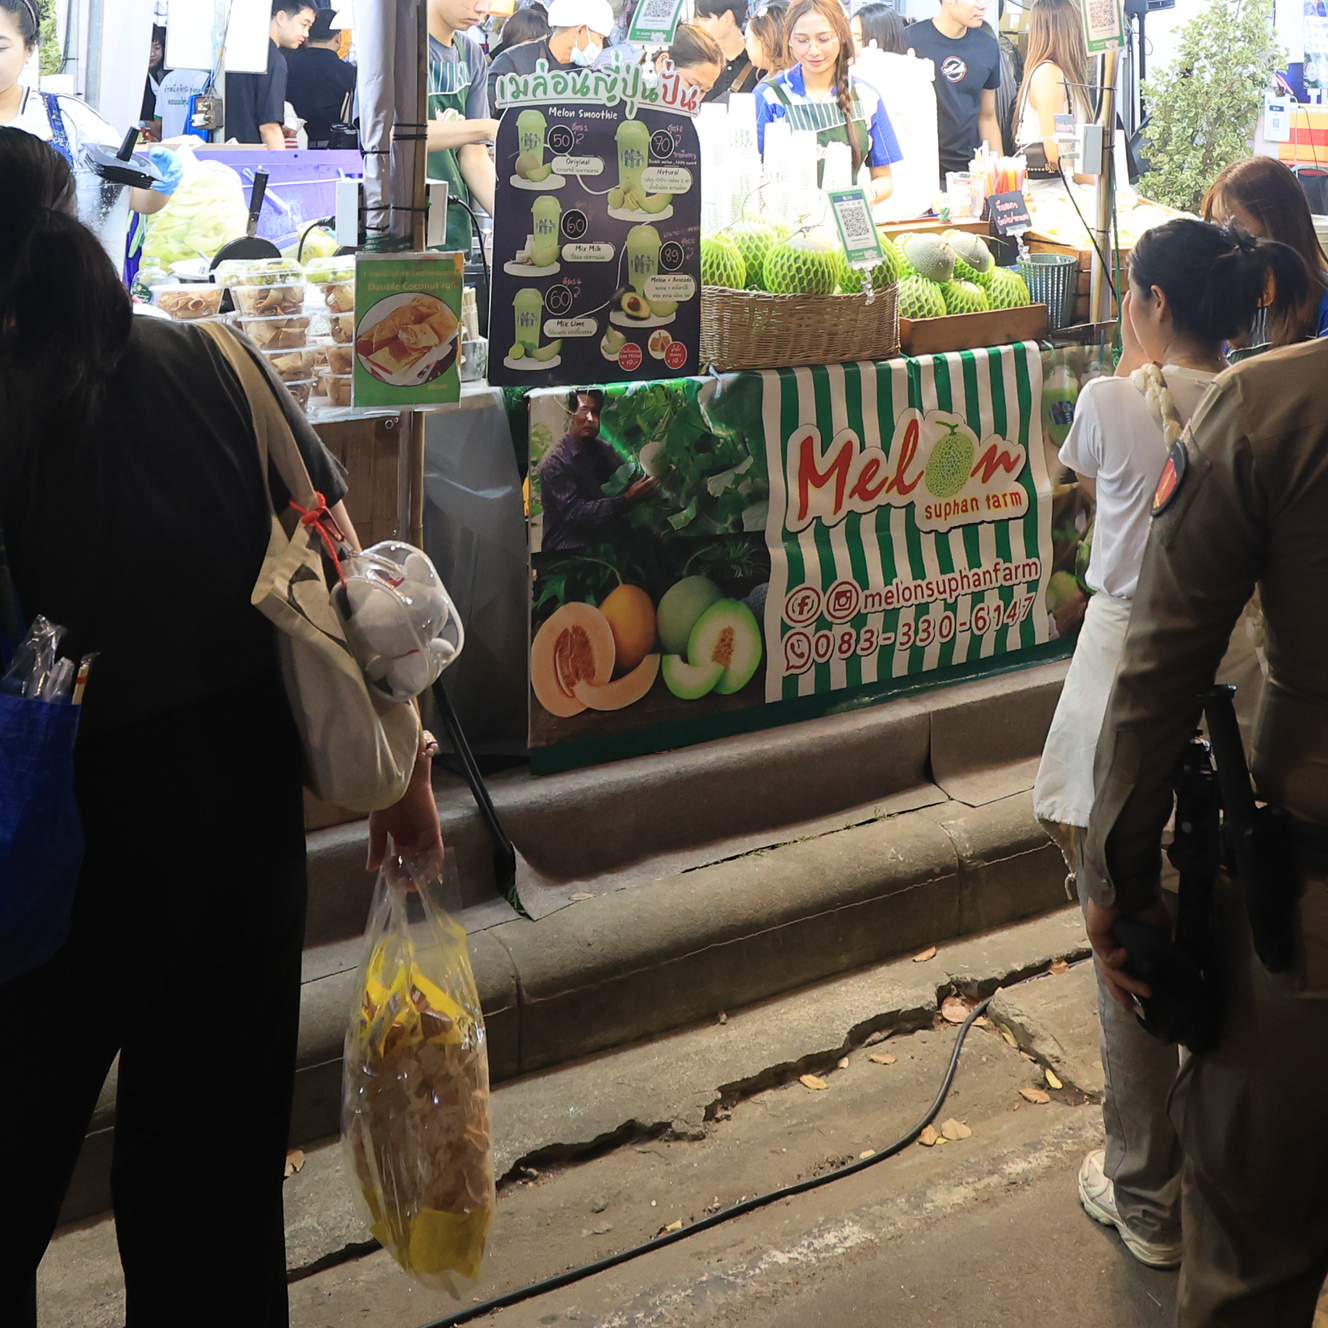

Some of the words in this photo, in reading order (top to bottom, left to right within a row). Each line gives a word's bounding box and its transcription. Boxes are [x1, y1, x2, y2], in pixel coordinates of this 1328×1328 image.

[548, 107, 575, 118] Melon
[578, 109, 619, 120] Smoothie
[553, 132, 570, 148] 50
[653, 135, 670, 152] 70
[565, 158, 591, 167] Original
[575, 244, 587, 252] Mix
[588, 244, 602, 252] Milk
[664, 248, 679, 263] 89
[368, 282, 401, 291] Double
[402, 281, 439, 291] Coconut
[550, 290, 570, 309] 60
[924, 495, 980, 522] suphan
[984, 490, 1023, 513] farm
[862, 558, 1040, 613] melonsuphanfarm
[814, 594, 1036, 661] 083-330-6147
